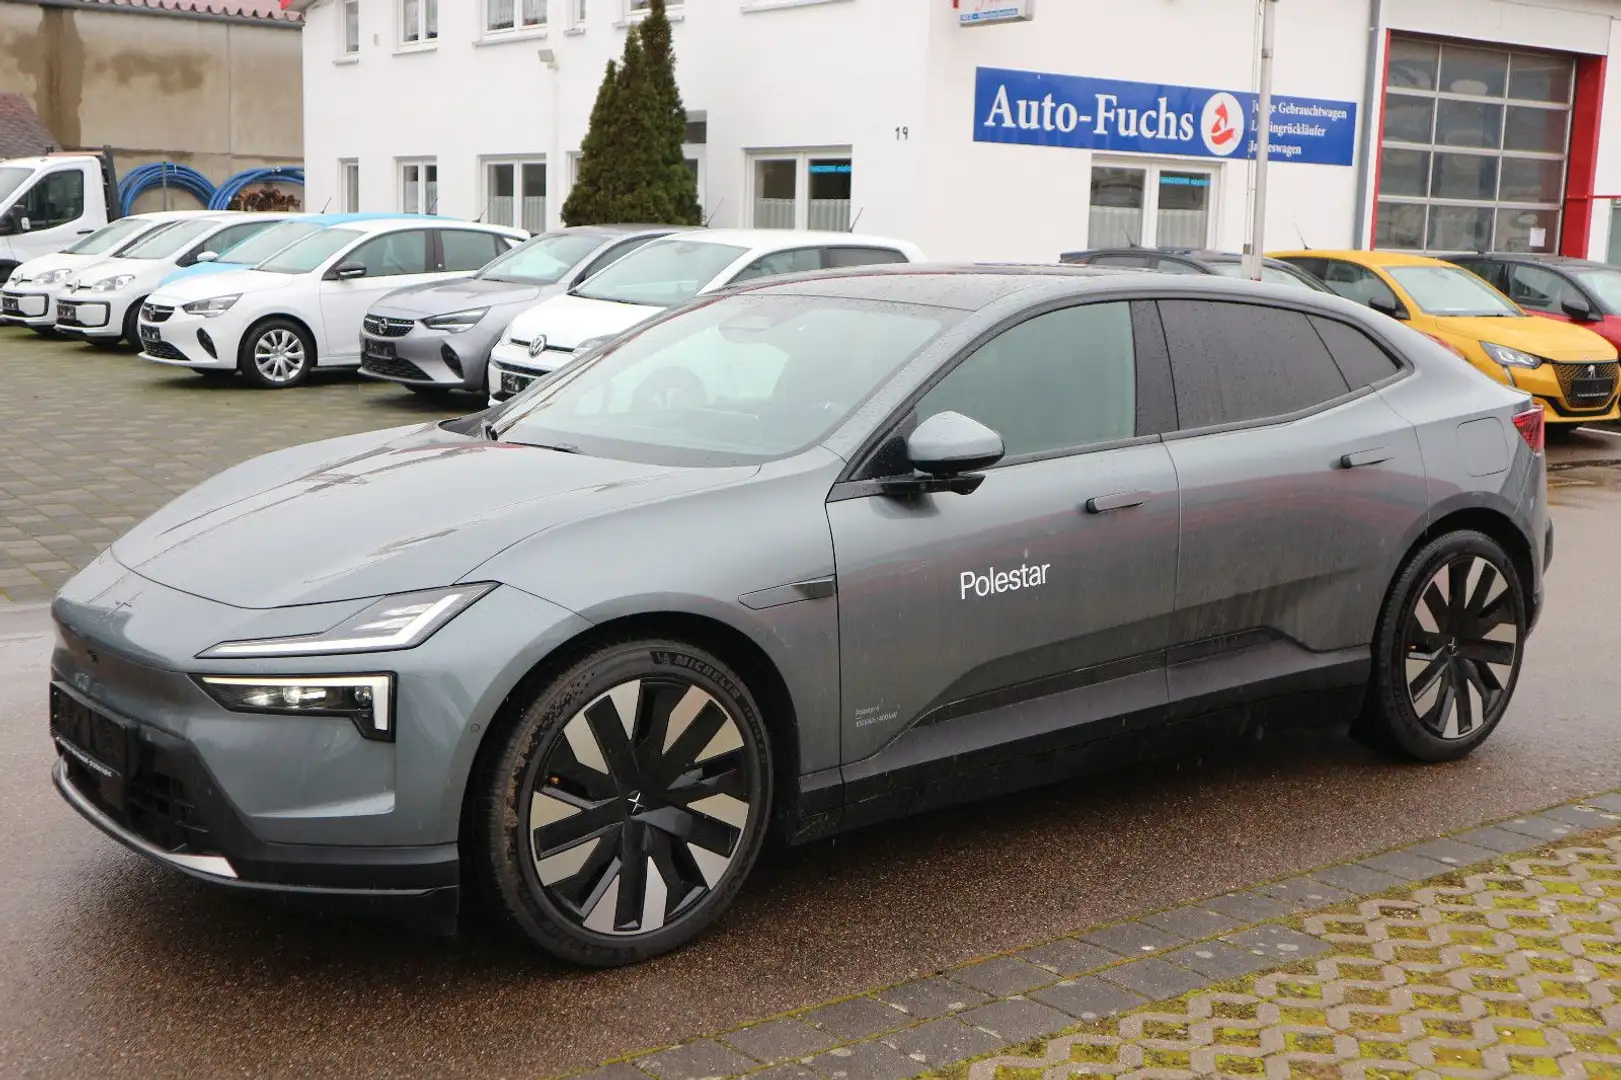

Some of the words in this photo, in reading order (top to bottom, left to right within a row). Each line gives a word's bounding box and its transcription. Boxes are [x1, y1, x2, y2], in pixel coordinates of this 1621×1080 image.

[983, 84, 1195, 142] Auto-Fuchs
[1278, 102, 1348, 121] Gebrauchtwagen
[895, 126, 909, 141] 19
[1250, 120, 1327, 137] Lingrückläufer
[1248, 140, 1302, 157] Jaeswagen
[960, 563, 1051, 600] Polestar
[674, 653, 741, 700] MICHELIN
